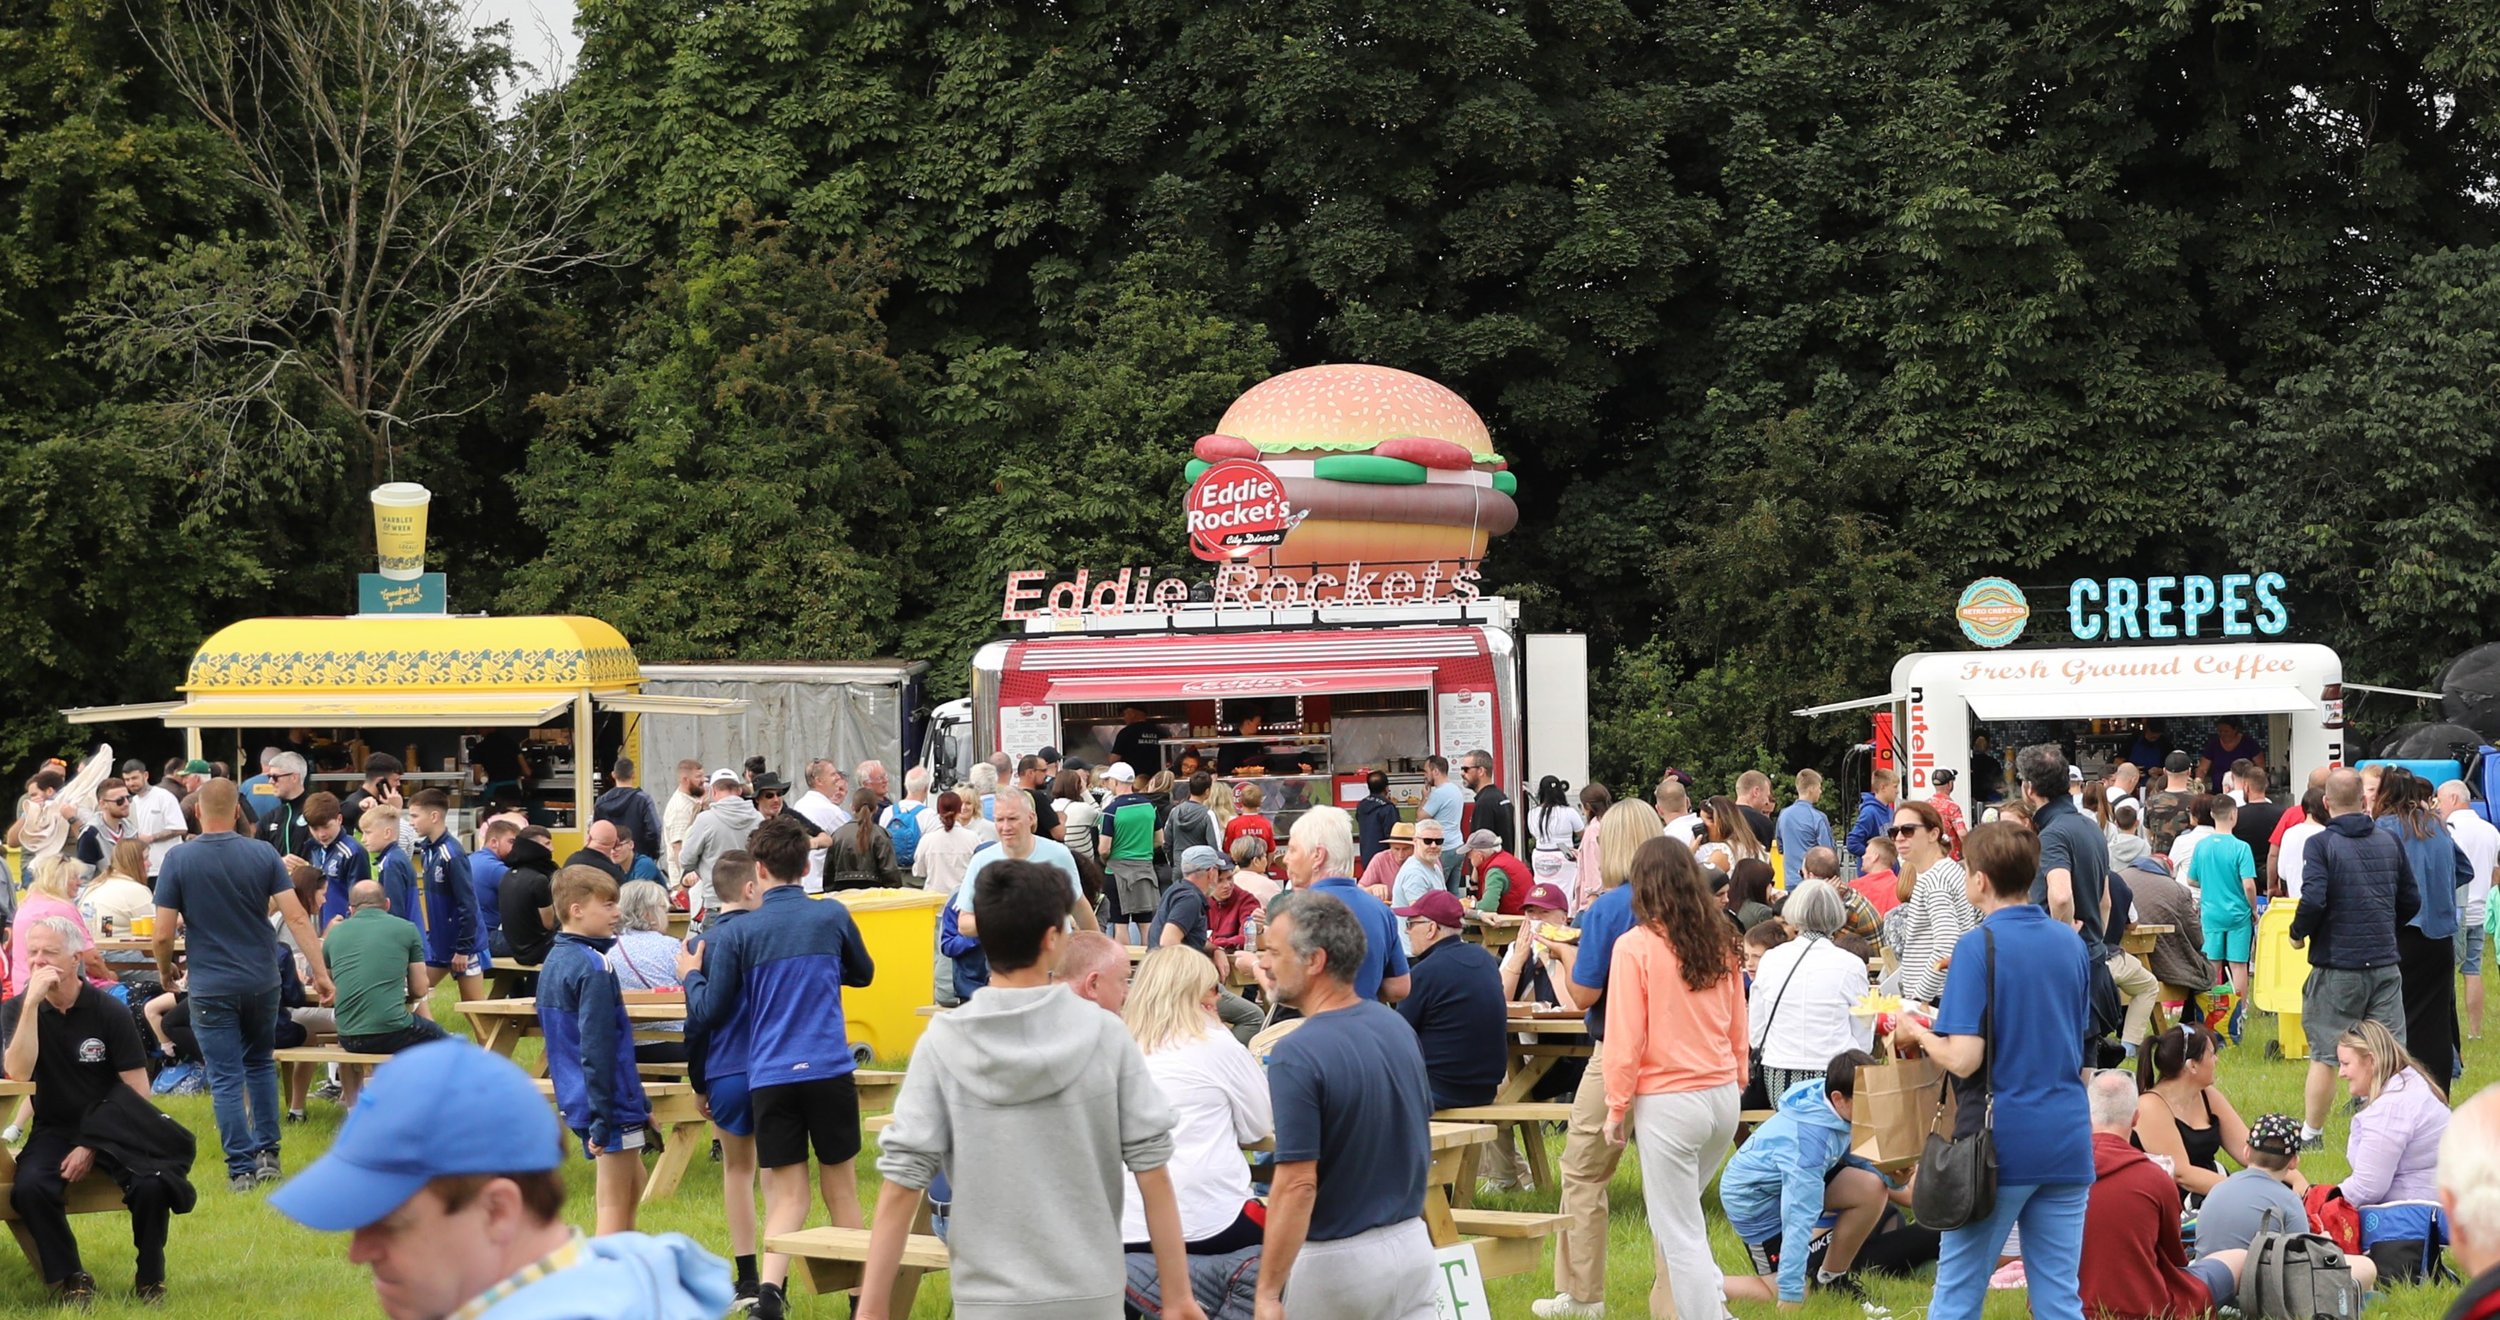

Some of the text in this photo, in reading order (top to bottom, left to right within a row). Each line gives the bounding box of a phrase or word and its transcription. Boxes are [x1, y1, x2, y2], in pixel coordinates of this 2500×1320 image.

[1202, 477, 1273, 508] Eddie
[1187, 495, 1290, 533] Rocket's
[1243, 533, 1280, 543] Diner
[1001, 559, 1482, 621] Eddie Rockets
[2066, 571, 2289, 640] CREPES
[1960, 653, 2297, 685] Fresh Ground Coffee
[1911, 687, 1934, 788] nutella
